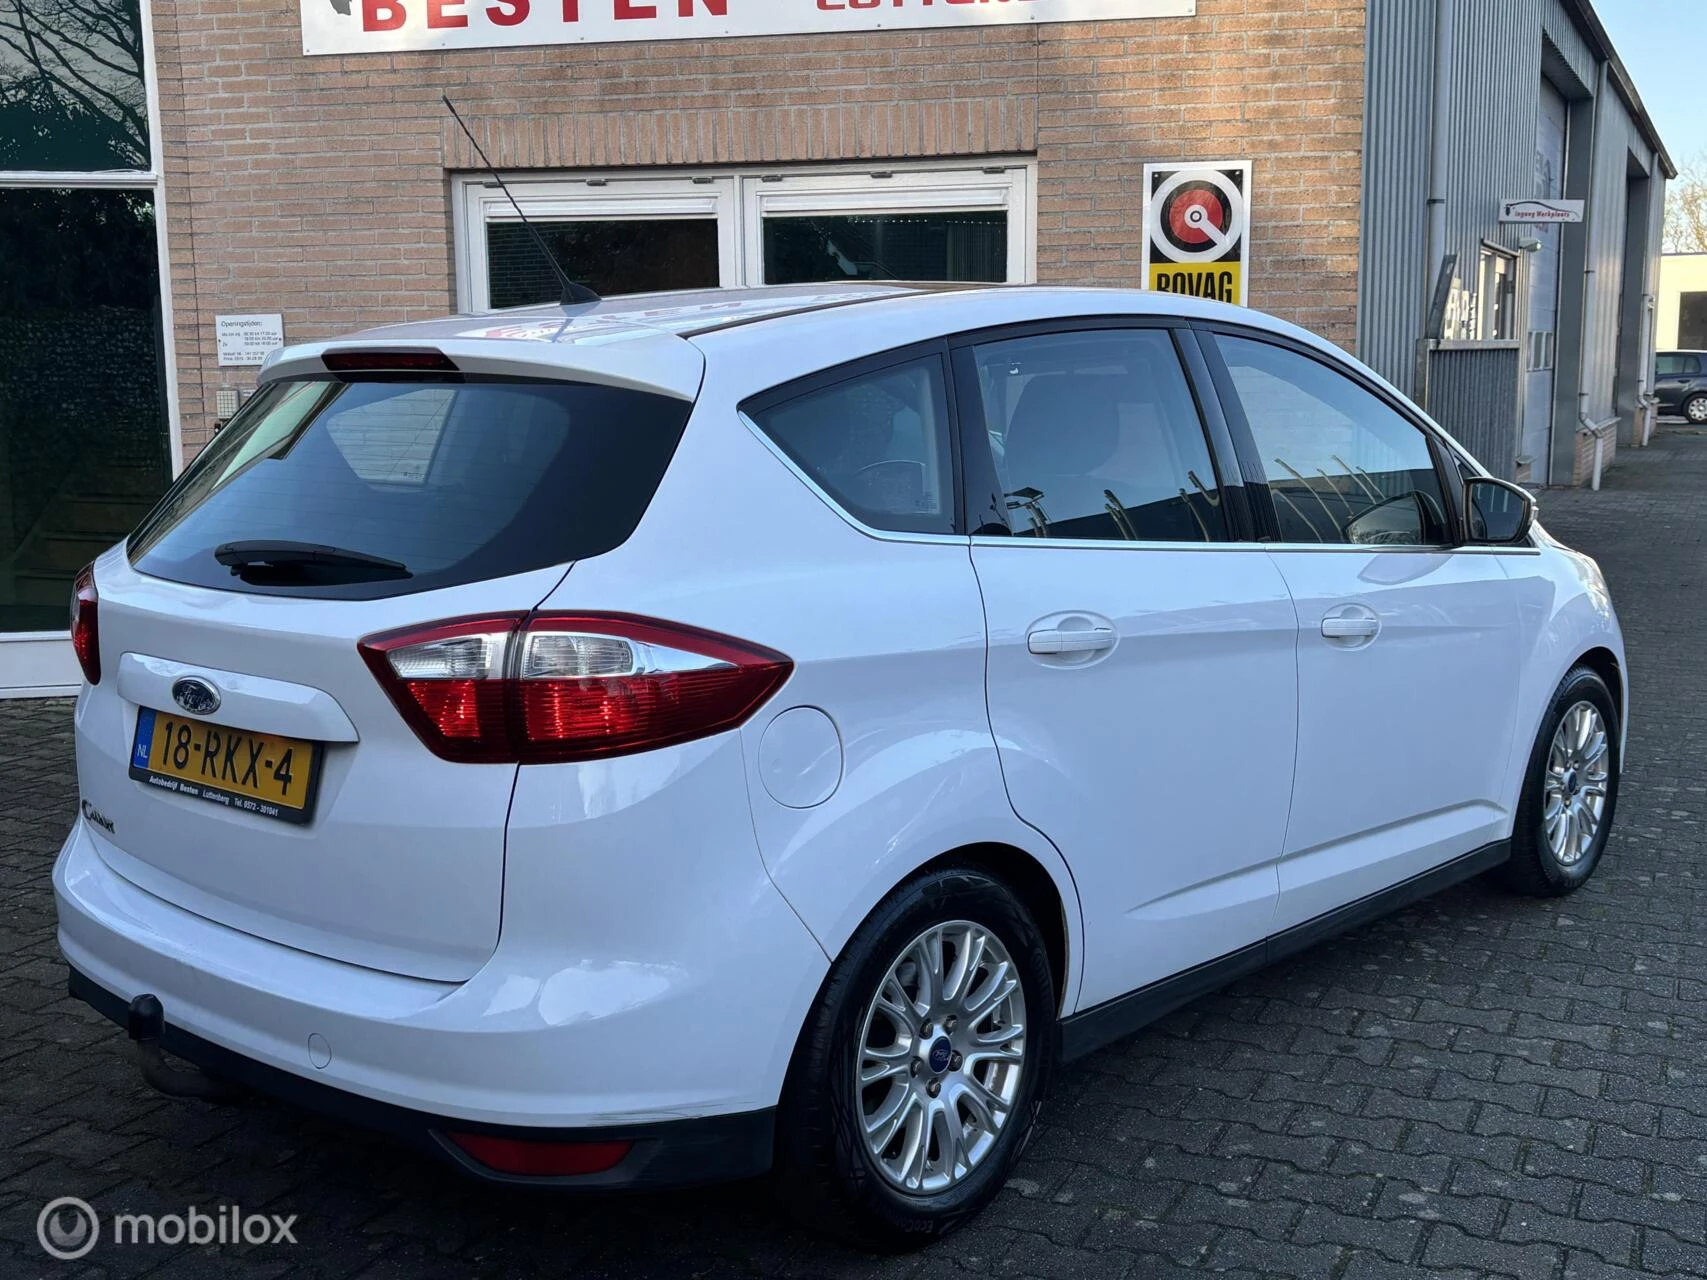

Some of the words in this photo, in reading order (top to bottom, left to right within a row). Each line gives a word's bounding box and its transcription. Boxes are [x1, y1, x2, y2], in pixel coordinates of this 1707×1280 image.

[362, 0, 728, 32] BES
[137, 743, 148, 759] NL
[162, 720, 293, 796] 18-RKX-4
[149, 775, 178, 791] Autobedrijf
[179, 783, 199, 796] Besten
[202, 789, 230, 806] Luttenberg
